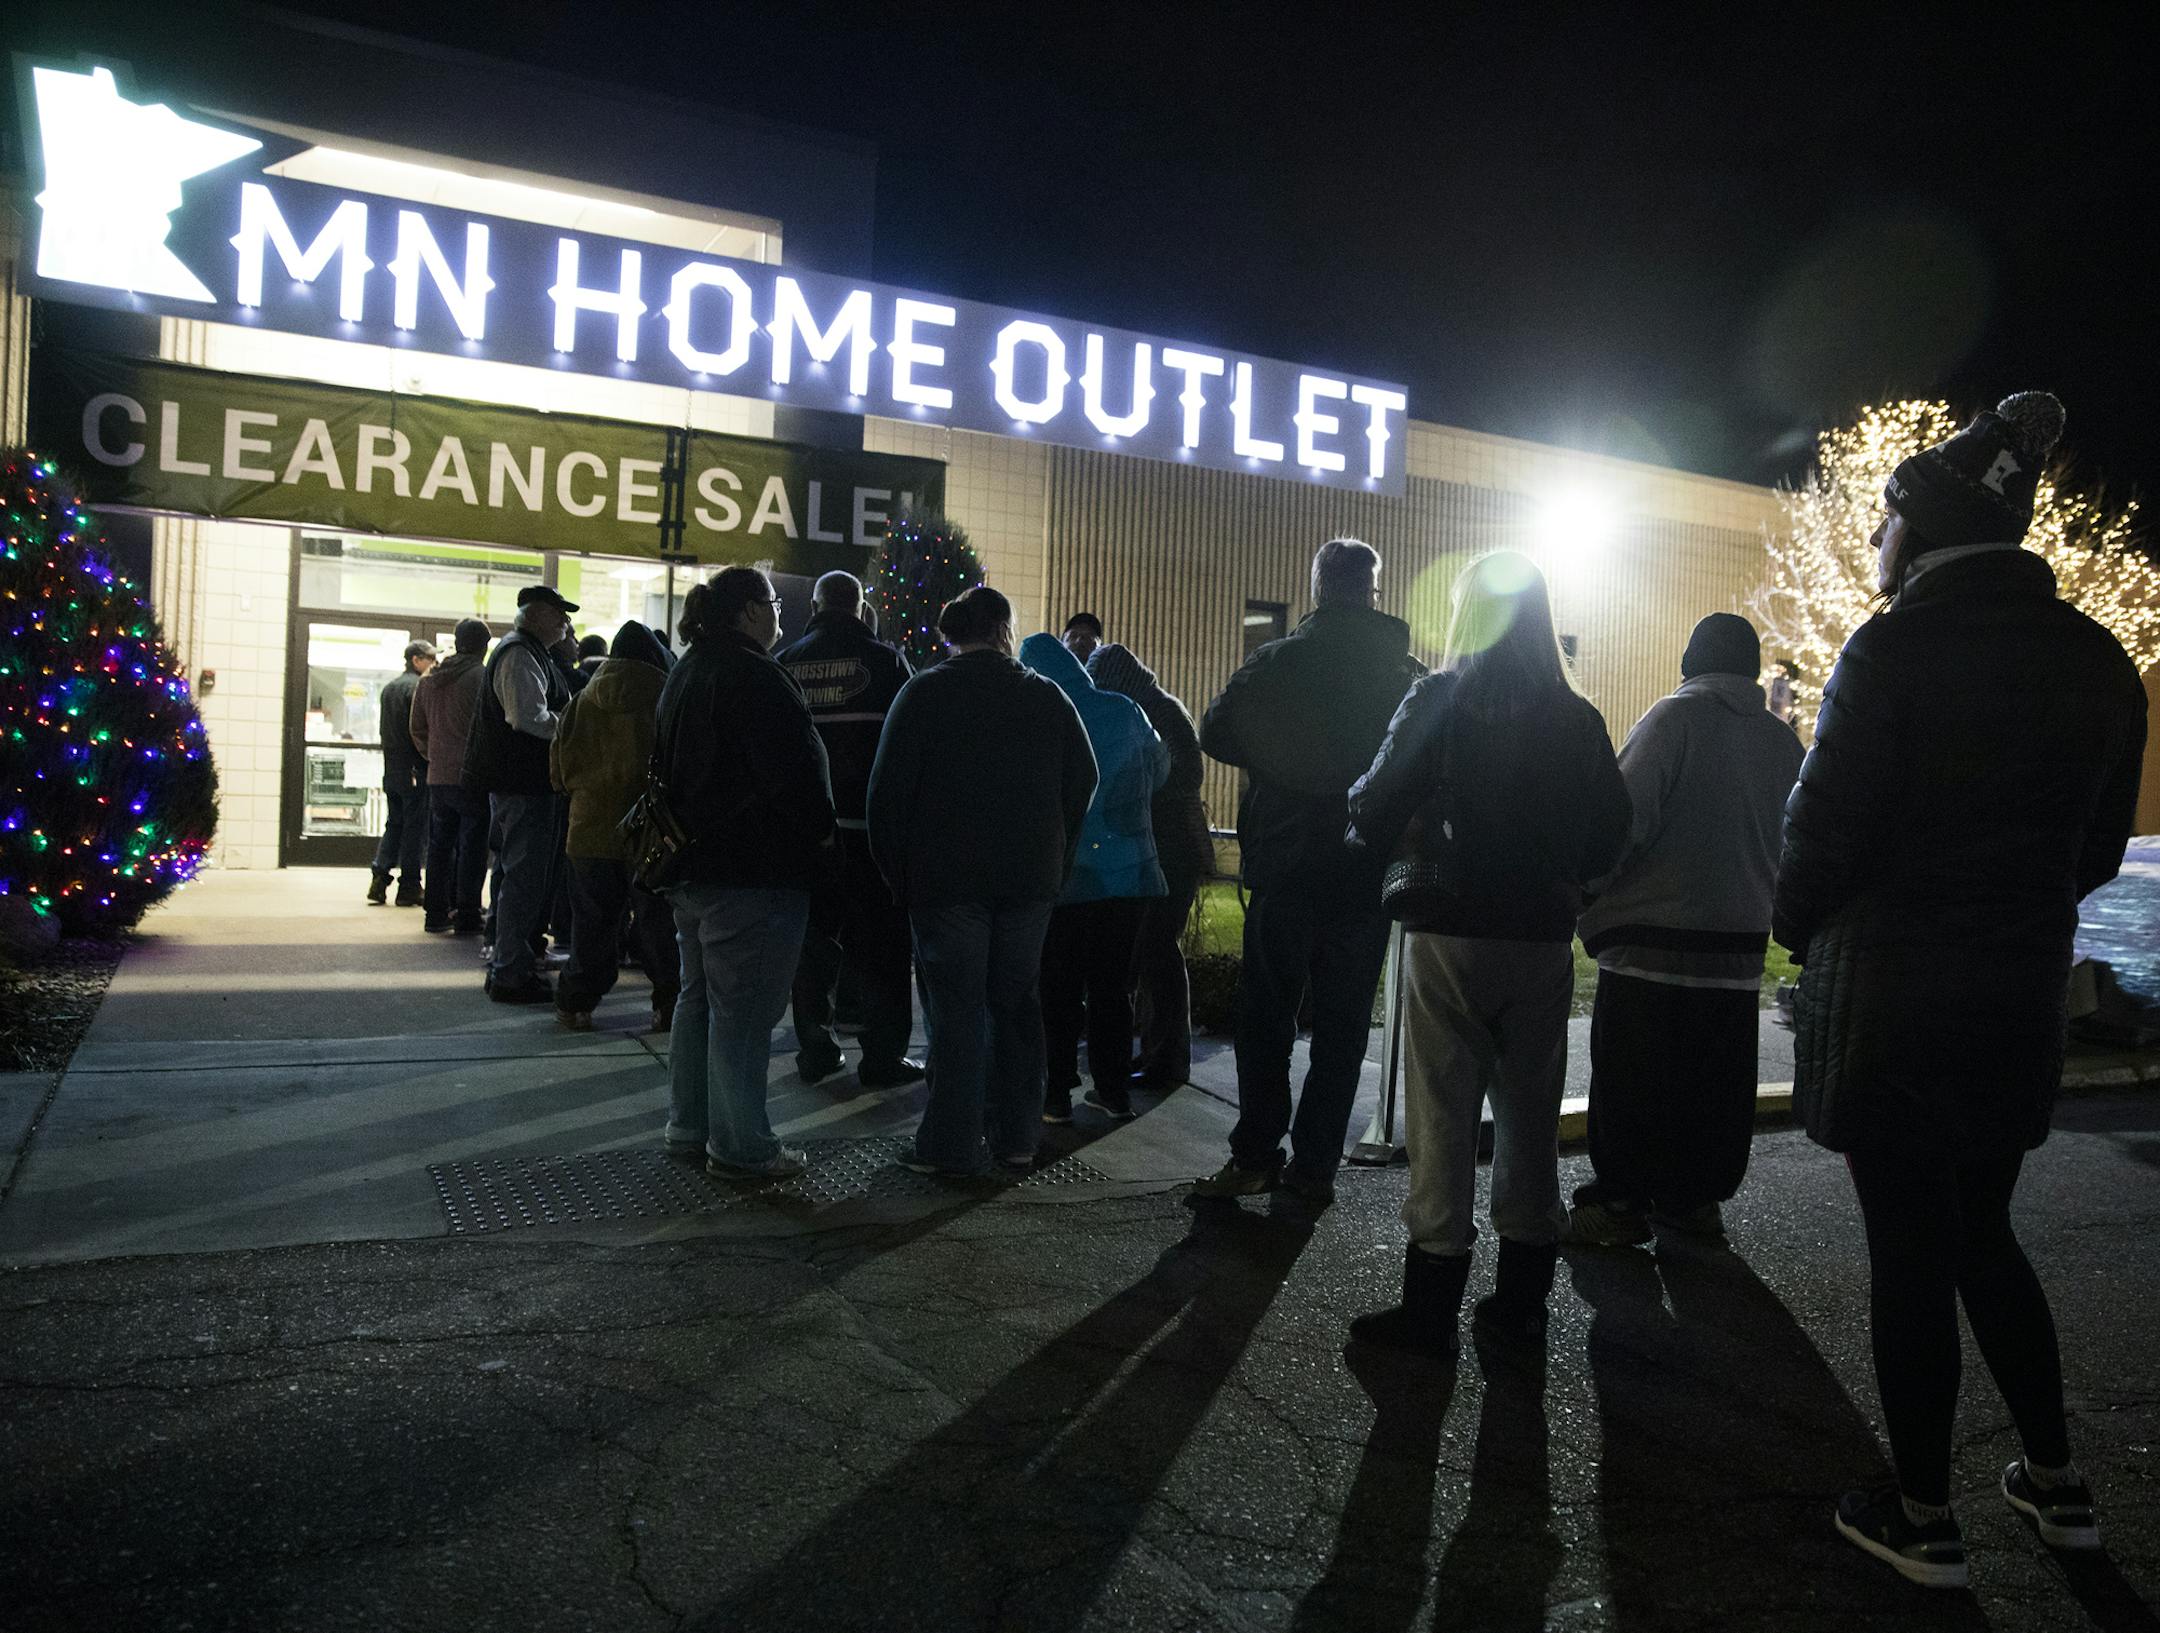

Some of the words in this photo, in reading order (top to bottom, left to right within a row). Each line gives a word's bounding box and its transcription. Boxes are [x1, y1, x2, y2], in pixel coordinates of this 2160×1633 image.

[230, 182, 495, 341] MN
[548, 238, 956, 409] HOME
[989, 320, 1406, 479] OUTLET
[81, 393, 662, 524] CLEARANCE
[803, 686, 844, 704] OWING
